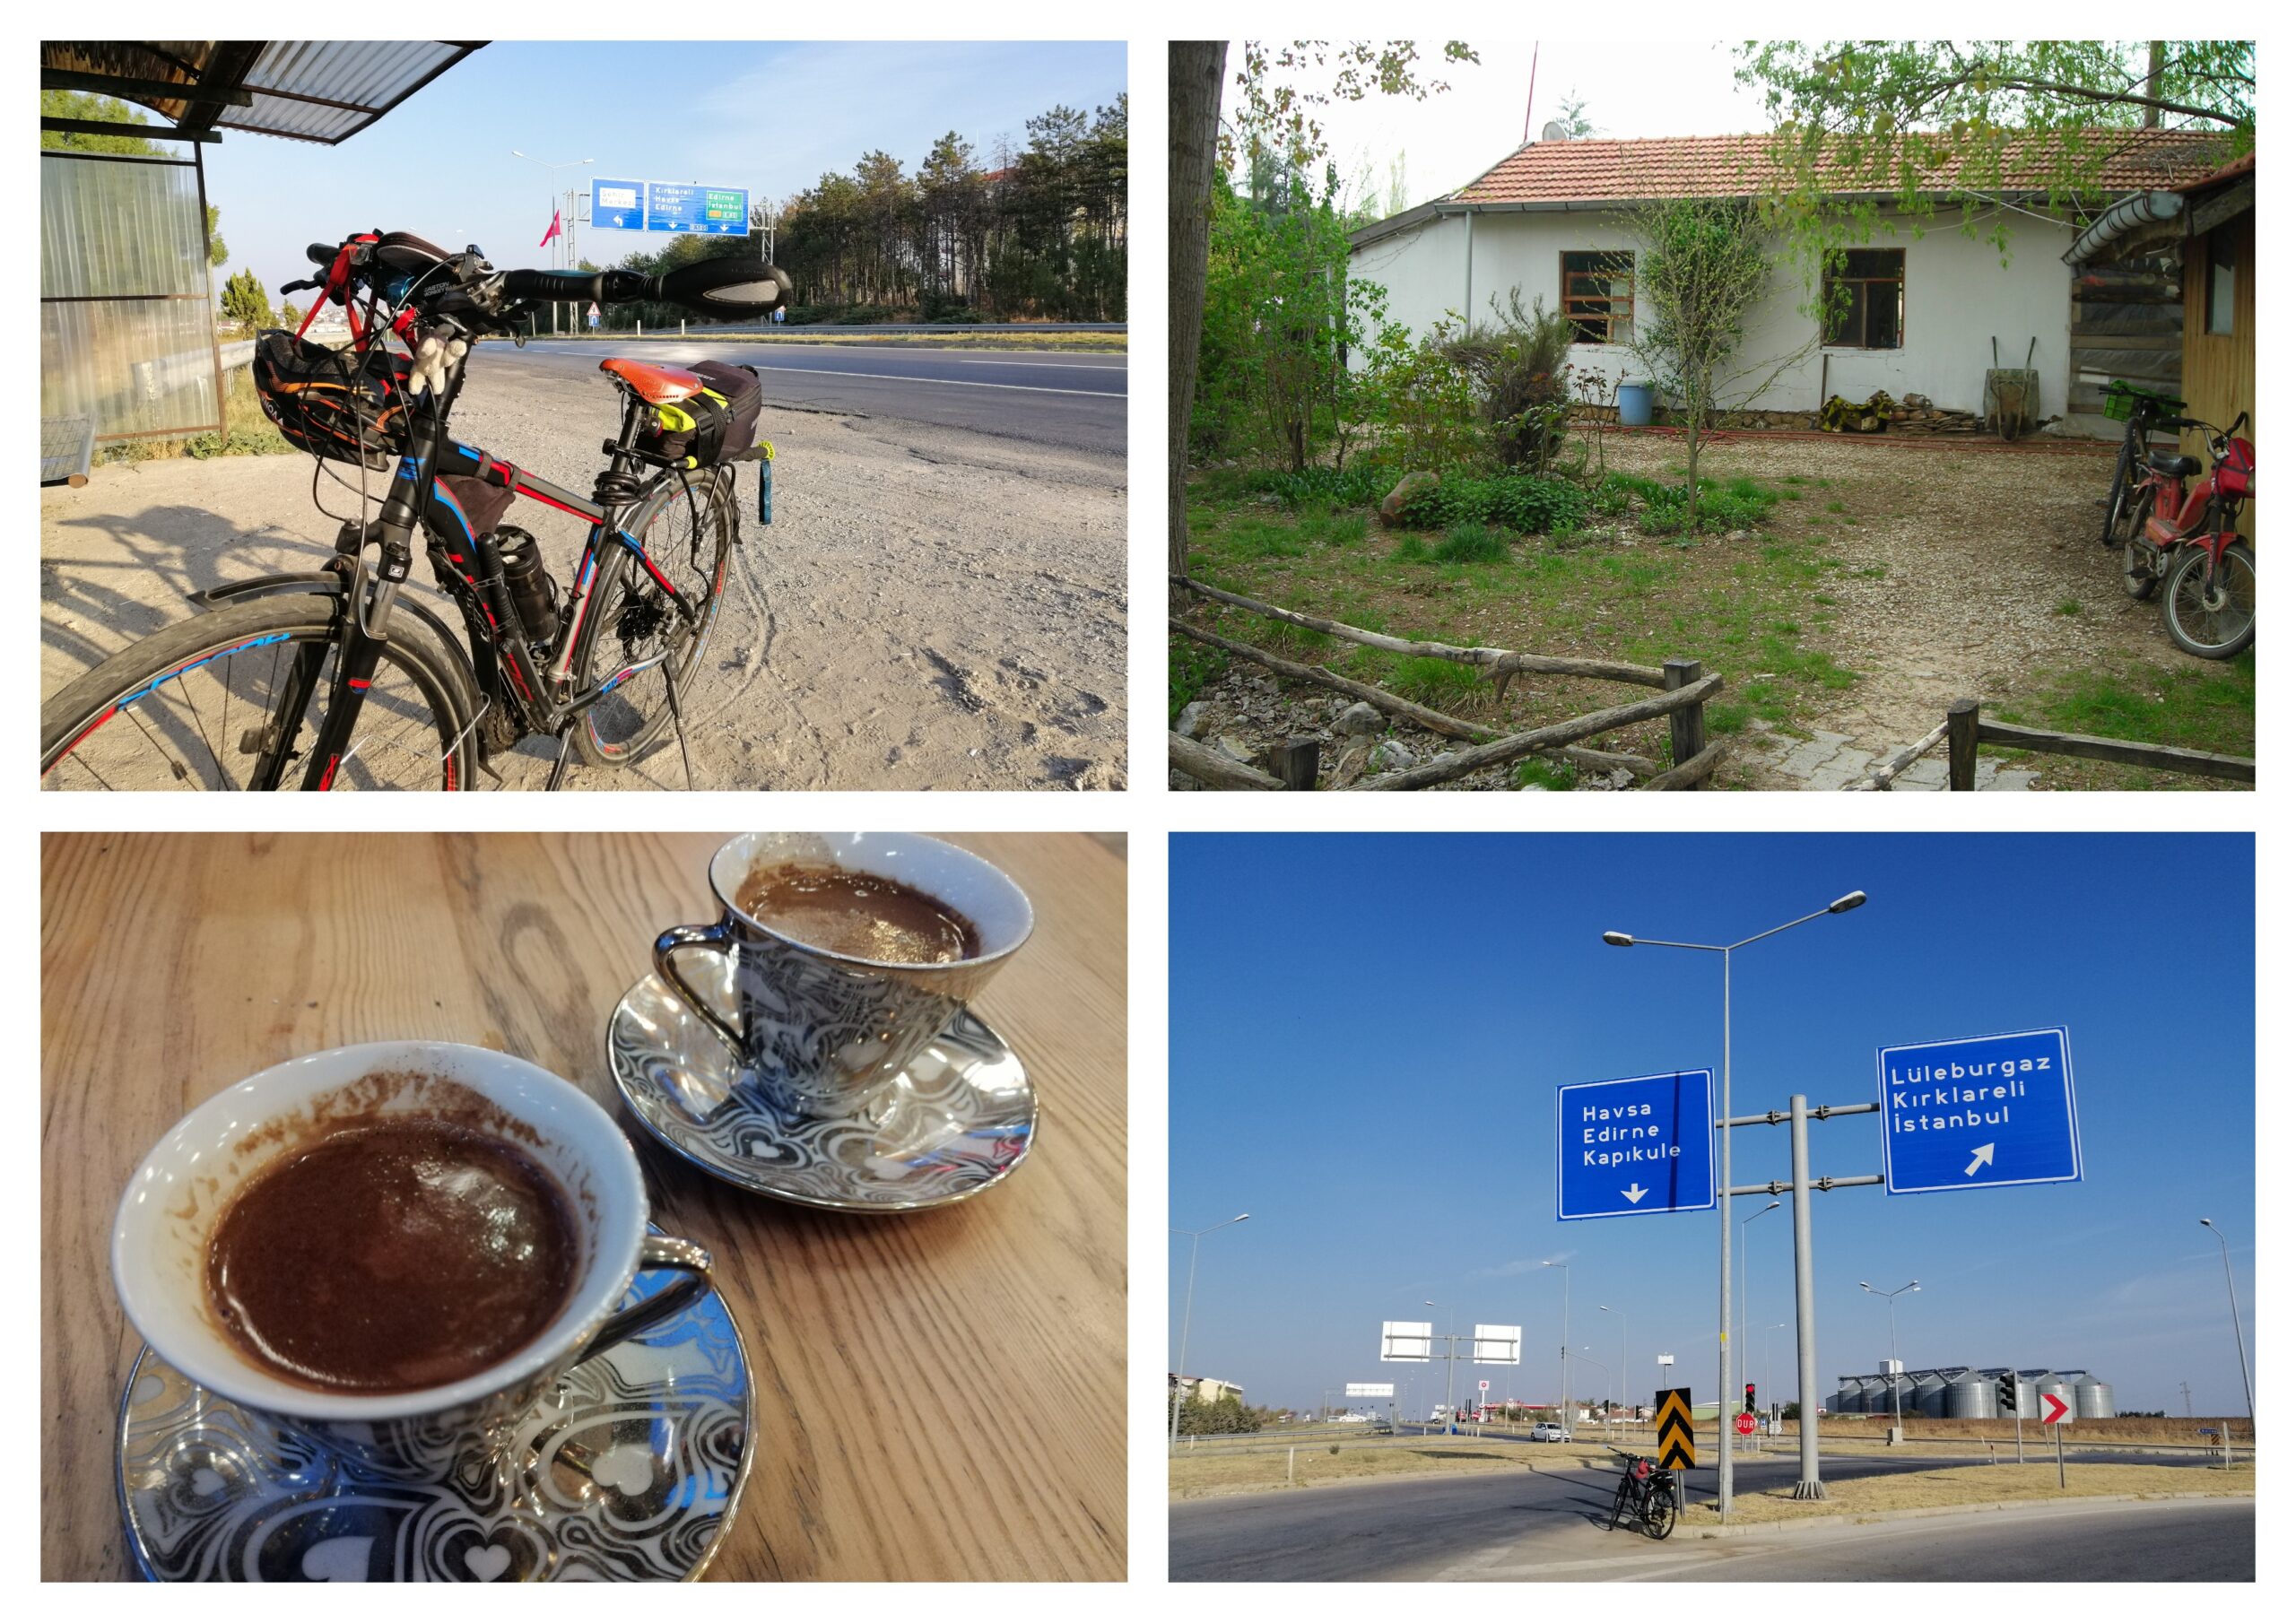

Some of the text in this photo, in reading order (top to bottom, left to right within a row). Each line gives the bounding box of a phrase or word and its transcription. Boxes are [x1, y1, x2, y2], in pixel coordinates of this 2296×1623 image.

[655, 203, 683, 212] Edirne
[708, 193, 735, 202] Edirne
[1892, 1056, 2051, 1085] Lüleburgaz
[1892, 1081, 2025, 1109] Kırklareli
[1583, 1103, 1651, 1122] Havsa
[1894, 1106, 2009, 1133] İstanbul
[1584, 1124, 1659, 1144] Edirne
[1584, 1142, 1681, 1167] Kapıkule
[1737, 1419, 1754, 1429] DUR
